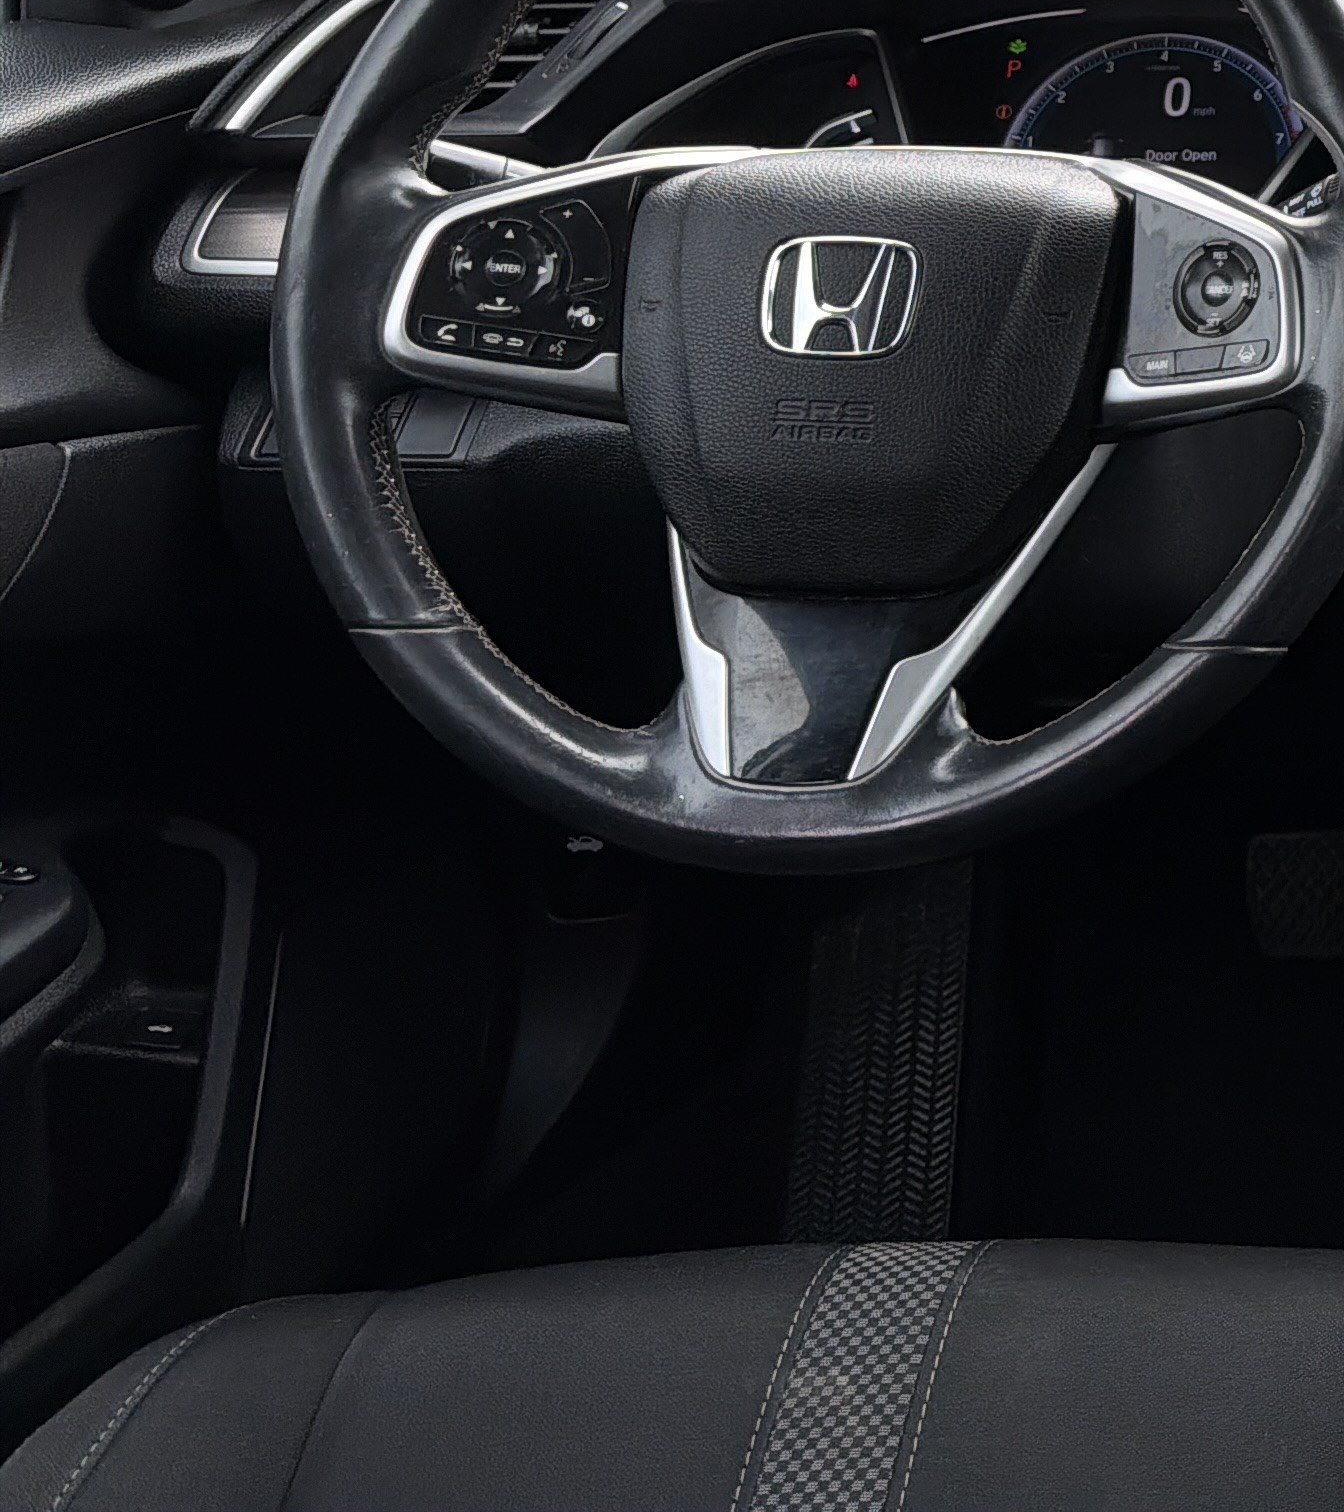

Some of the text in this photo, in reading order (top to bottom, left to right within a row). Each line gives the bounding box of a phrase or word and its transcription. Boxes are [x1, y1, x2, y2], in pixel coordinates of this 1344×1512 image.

[1160, 50, 1169, 61] 4
[1007, 59, 1022, 79] P
[1106, 61, 1115, 73] 3
[1213, 60, 1223, 72] 5
[1056, 91, 1067, 104] 2
[1164, 76, 1217, 117] 0 mph
[1252, 89, 1263, 102] 6
[1275, 133, 1284, 145] 7
[1146, 149, 1217, 163] Door Open
[489, 263, 521, 274] ENTER
[1146, 359, 1169, 371] MAIN
